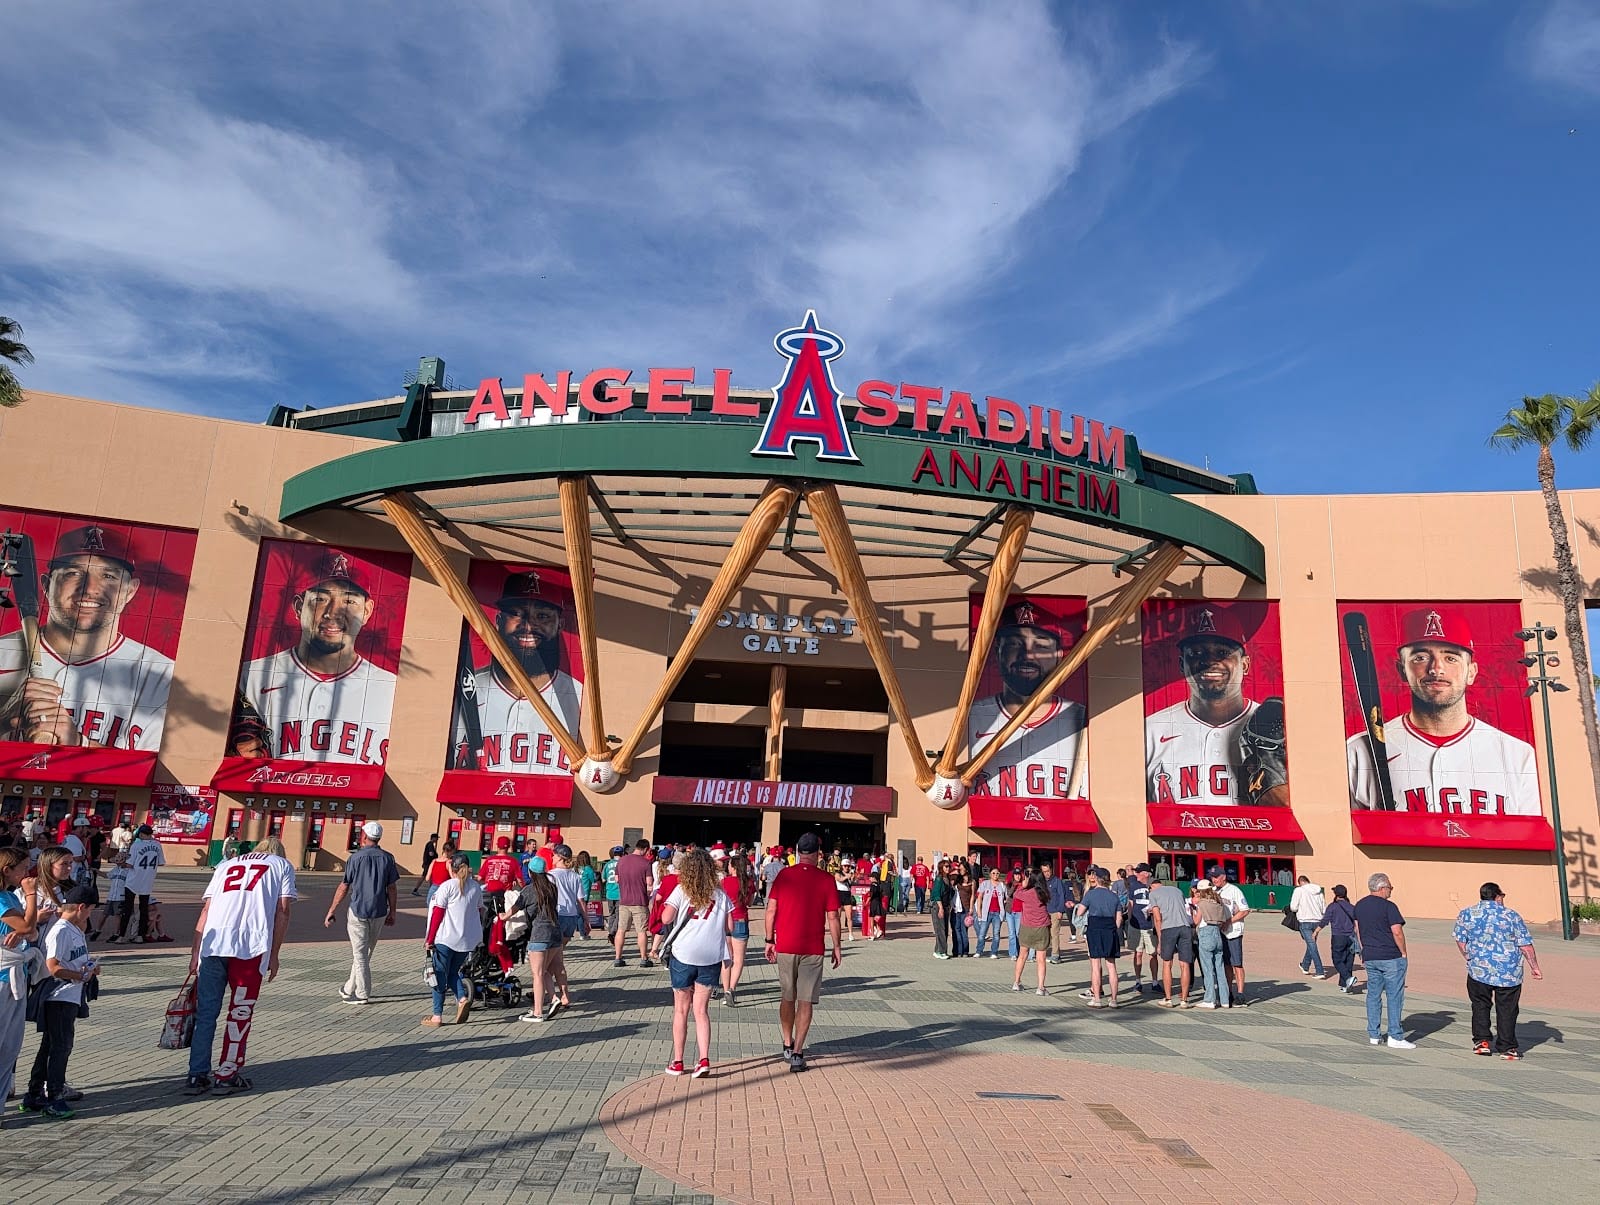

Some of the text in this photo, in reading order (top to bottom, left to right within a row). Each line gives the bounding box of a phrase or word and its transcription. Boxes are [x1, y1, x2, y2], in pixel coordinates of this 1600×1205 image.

[464, 309, 1126, 471] ANGEL A STADIUM
[912, 446, 1121, 518] ANAHEIM
[689, 608, 863, 635] OMEPLAT
[742, 634, 820, 655] GATE
[279, 719, 390, 766] NGELS
[246, 765, 351, 788] ANGELS
[245, 797, 355, 812] TICKETS
[693, 778, 752, 805] ANGELS
[774, 783, 854, 810] MARINERS
[456, 808, 557, 822] TICKETS
[1180, 811, 1273, 831] ANGELS
[1161, 840, 1278, 854] TEAM STORE
[139, 855, 158, 870] 44
[222, 863, 270, 893] 27
